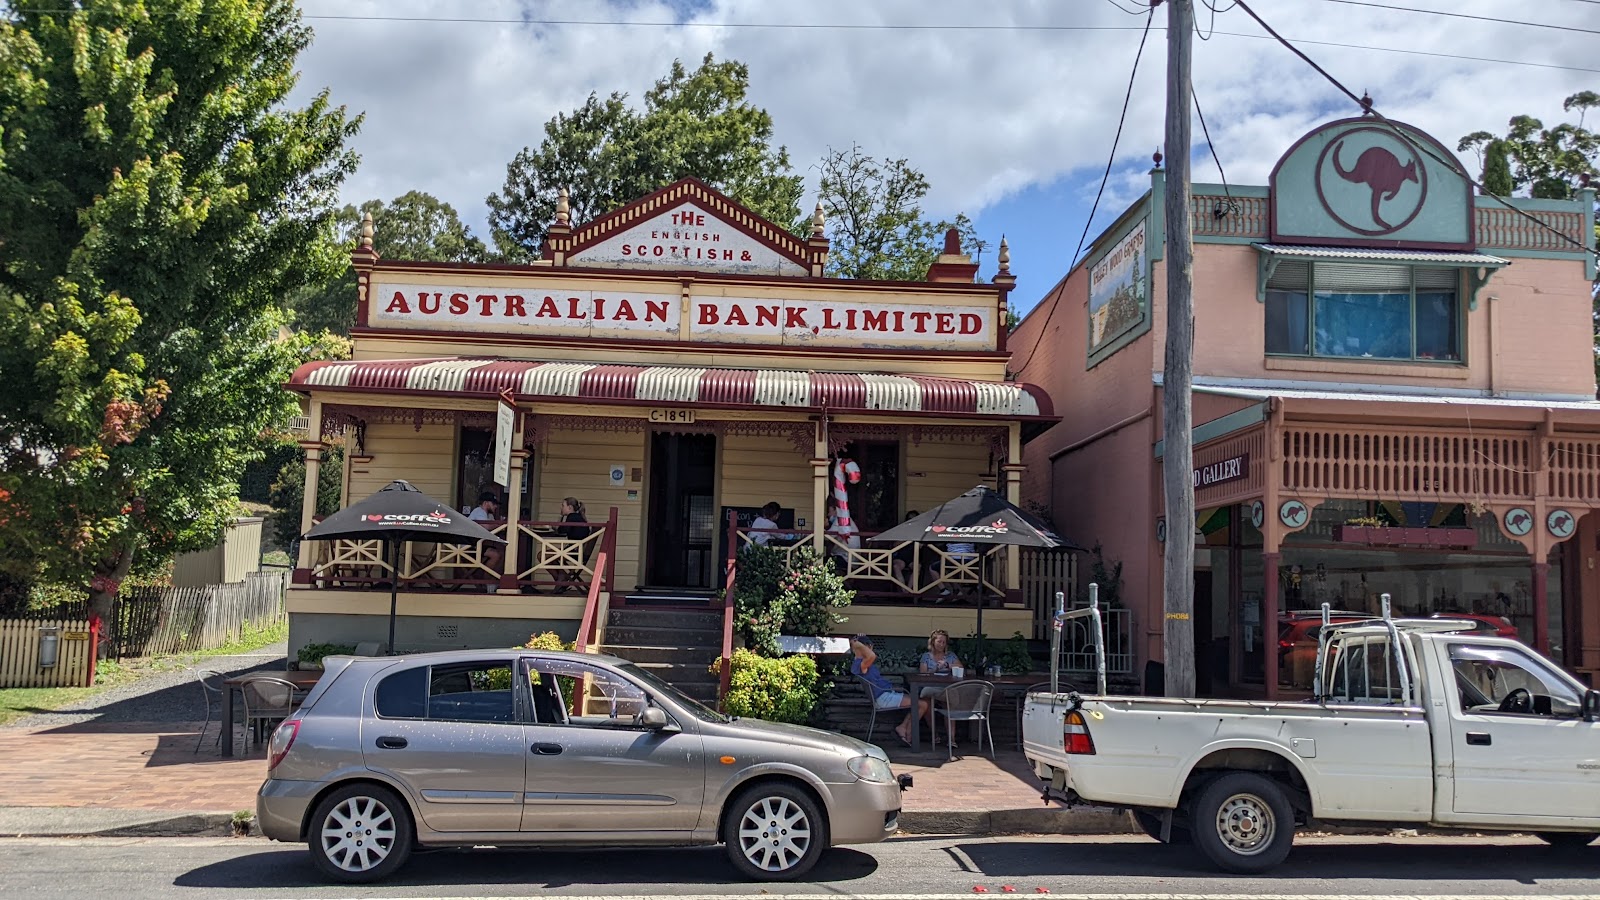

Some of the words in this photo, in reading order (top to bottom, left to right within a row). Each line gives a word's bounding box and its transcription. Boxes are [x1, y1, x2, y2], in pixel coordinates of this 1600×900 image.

[671, 211, 705, 226] THE
[651, 231, 720, 242] ENGLISH
[621, 244, 733, 260] SCOTTISH
[740, 250, 752, 261] &
[385, 291, 670, 323] AUSTRALIAN
[821, 308, 983, 335] LIMITED
[651, 410, 691, 422] C-1891
[1202, 456, 1242, 485] GALLERY
[384, 513, 451, 524] coffee
[726, 508, 751, 520] Bcon
[946, 525, 1008, 534] coffee
